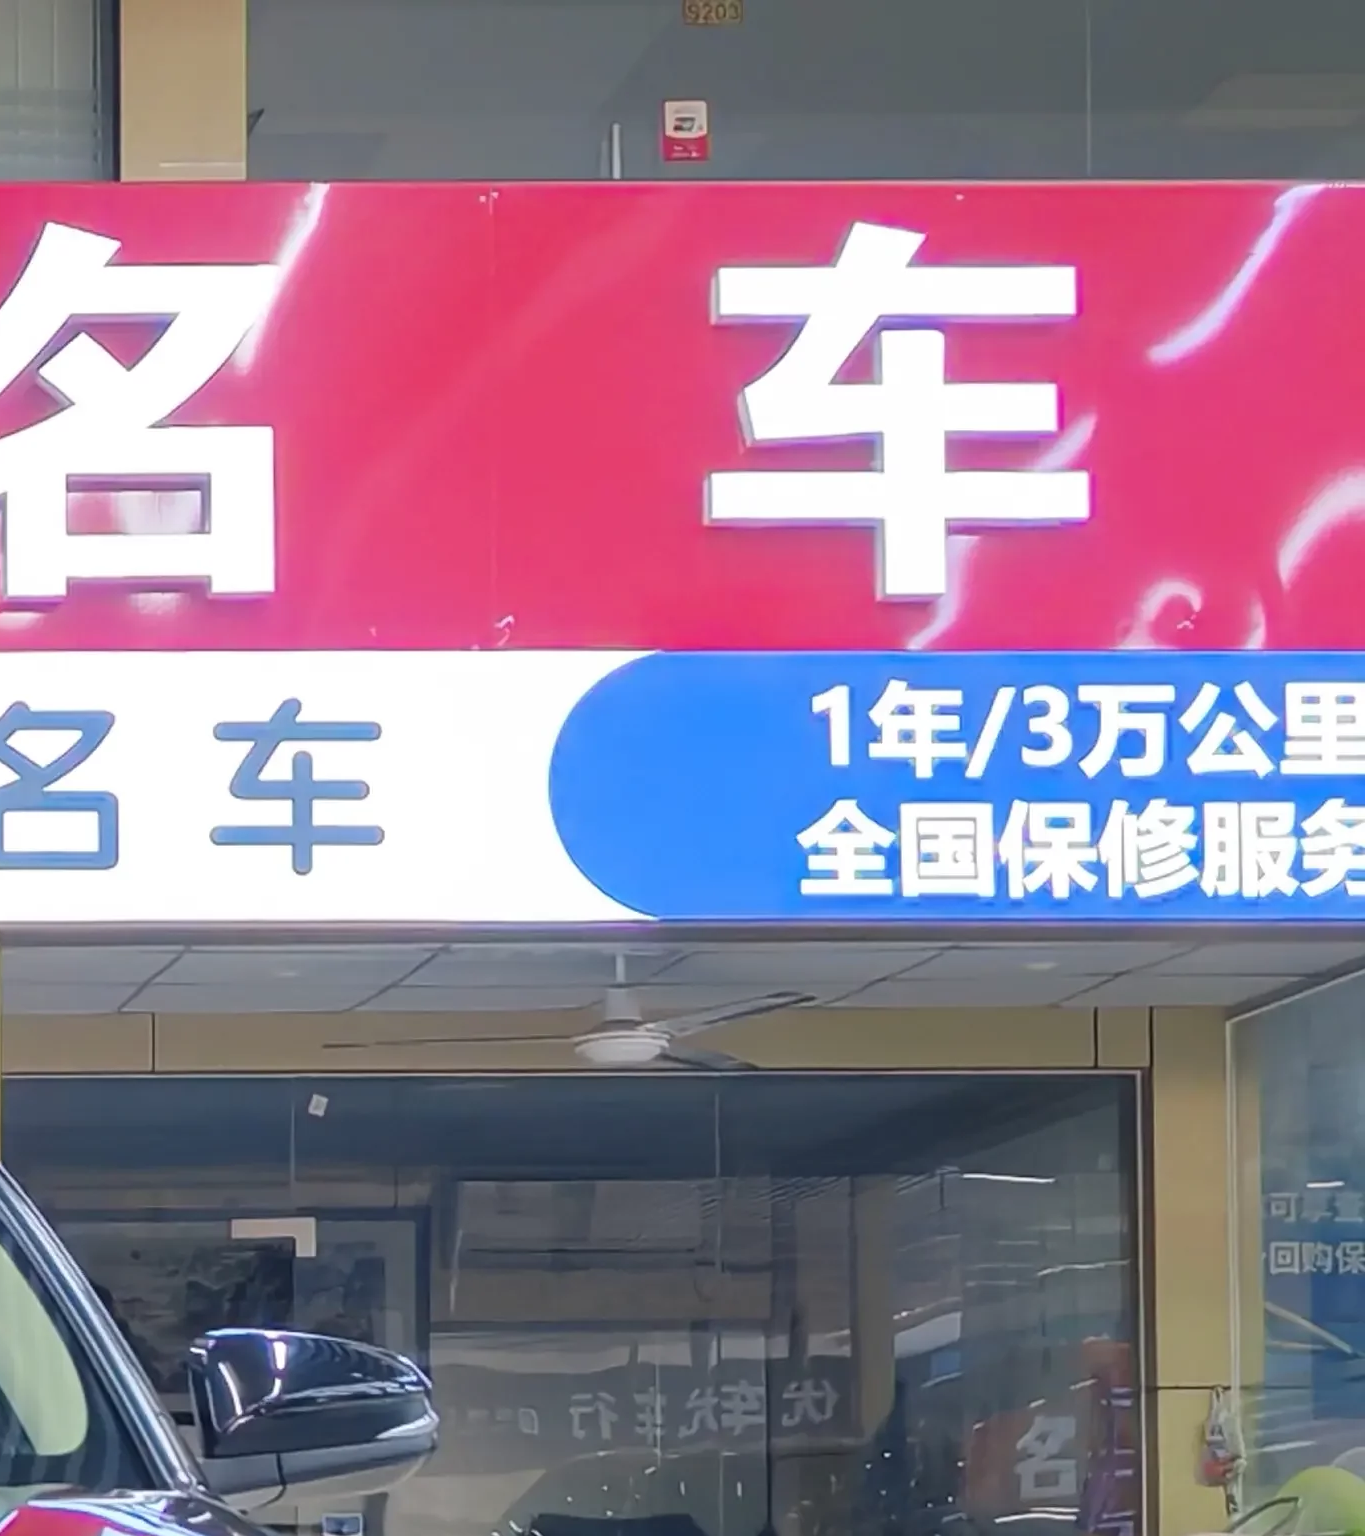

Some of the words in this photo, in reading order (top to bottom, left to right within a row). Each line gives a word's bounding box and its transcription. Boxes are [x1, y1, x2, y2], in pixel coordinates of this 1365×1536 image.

[811, 678, 1365, 779] 1年/3万公里
[797, 798, 1365, 900] 全国保修服务
